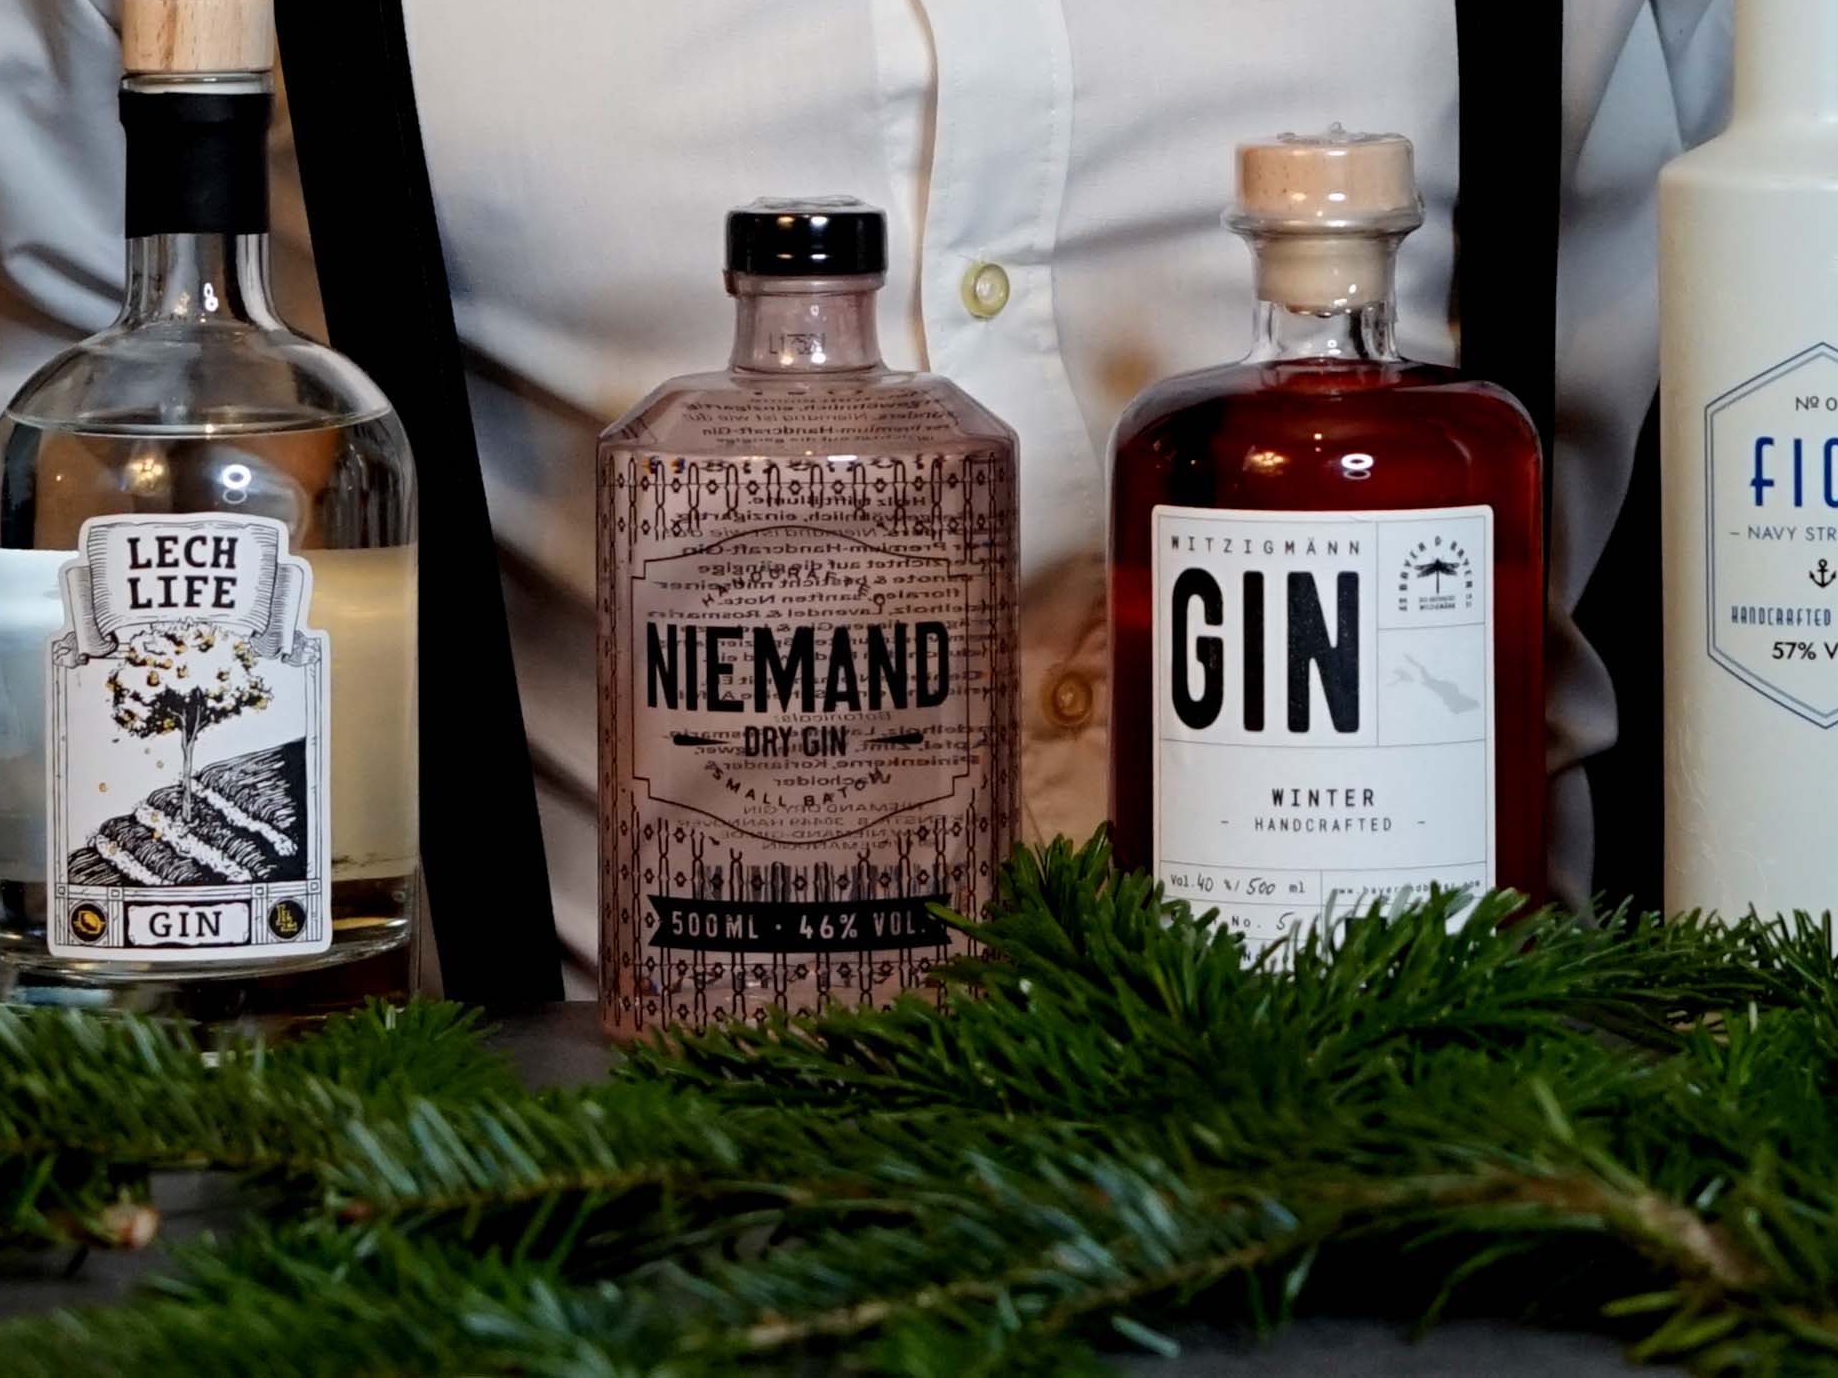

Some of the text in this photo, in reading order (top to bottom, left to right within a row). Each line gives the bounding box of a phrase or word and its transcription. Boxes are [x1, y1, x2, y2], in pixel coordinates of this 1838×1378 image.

[1747, 526, 1797, 541] NAVY
[128, 535, 239, 570] LECH
[129, 576, 238, 609] LIFE
[1731, 606, 1832, 627] HANDCRAFTED
[1171, 568, 1360, 733] GIN
[1772, 641, 1817, 660] 57%
[647, 621, 949, 715] NIEMAND
[745, 725, 847, 757] DRY GIN
[712, 766, 787, 808] SMALL
[1272, 788, 1375, 807] WINTER
[1254, 817, 1393, 832] HANDCRAFTED
[1170, 874, 1195, 888] Vol.
[1246, 876, 1276, 896] 500
[1288, 881, 1306, 894] ml
[149, 909, 223, 938] GIN
[671, 910, 928, 941] 500ML 46% VOL.
[1232, 915, 1261, 929] No.
